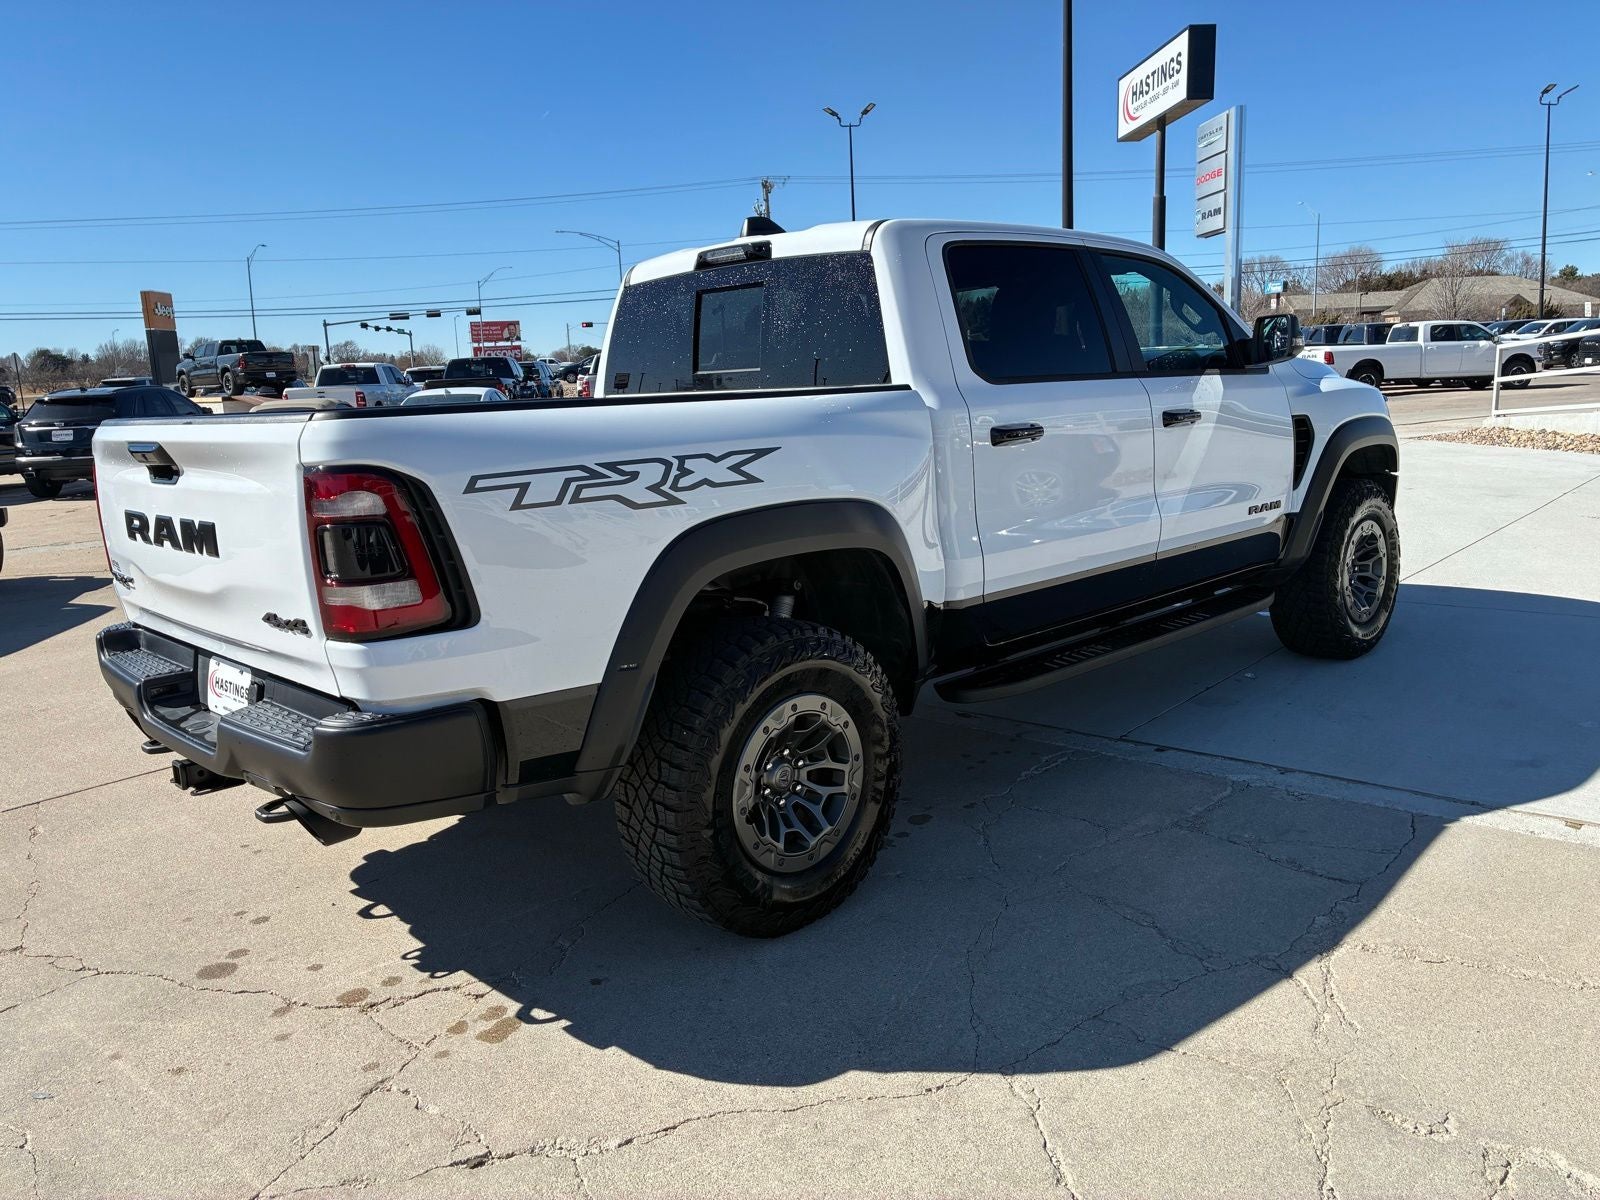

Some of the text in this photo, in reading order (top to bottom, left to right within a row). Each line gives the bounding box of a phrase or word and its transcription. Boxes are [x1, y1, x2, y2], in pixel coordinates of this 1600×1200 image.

[1131, 51, 1182, 105] HASTINGS
[1197, 125, 1224, 142] CHRYSLER
[1196, 167, 1223, 186] DODGE
[1201, 206, 1222, 221] RAM
[462, 446, 783, 512] TRX
[1248, 499, 1281, 515] RAM
[124, 509, 220, 559] RAM
[214, 675, 250, 701] HASTINGS
